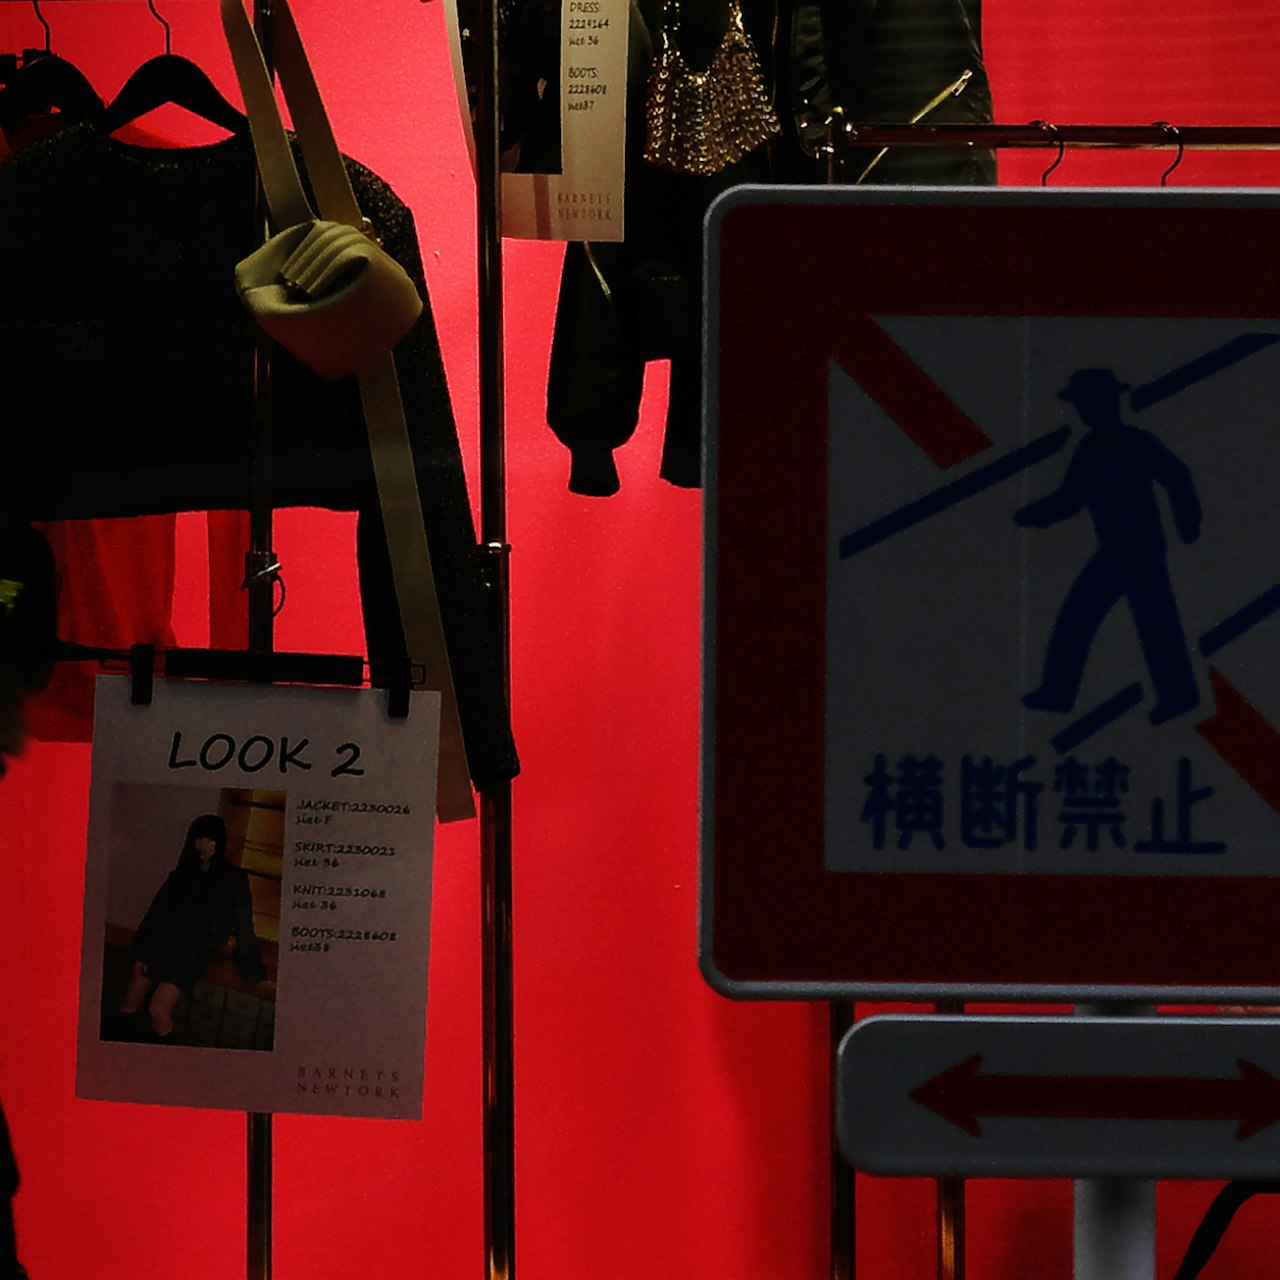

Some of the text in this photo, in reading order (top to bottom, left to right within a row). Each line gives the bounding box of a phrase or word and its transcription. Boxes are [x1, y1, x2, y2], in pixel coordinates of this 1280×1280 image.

[169, 731, 365, 777] LOOK 2
[861, 753, 1227, 854] 横断禁止
[297, 1066, 399, 1083] BARNEYS
